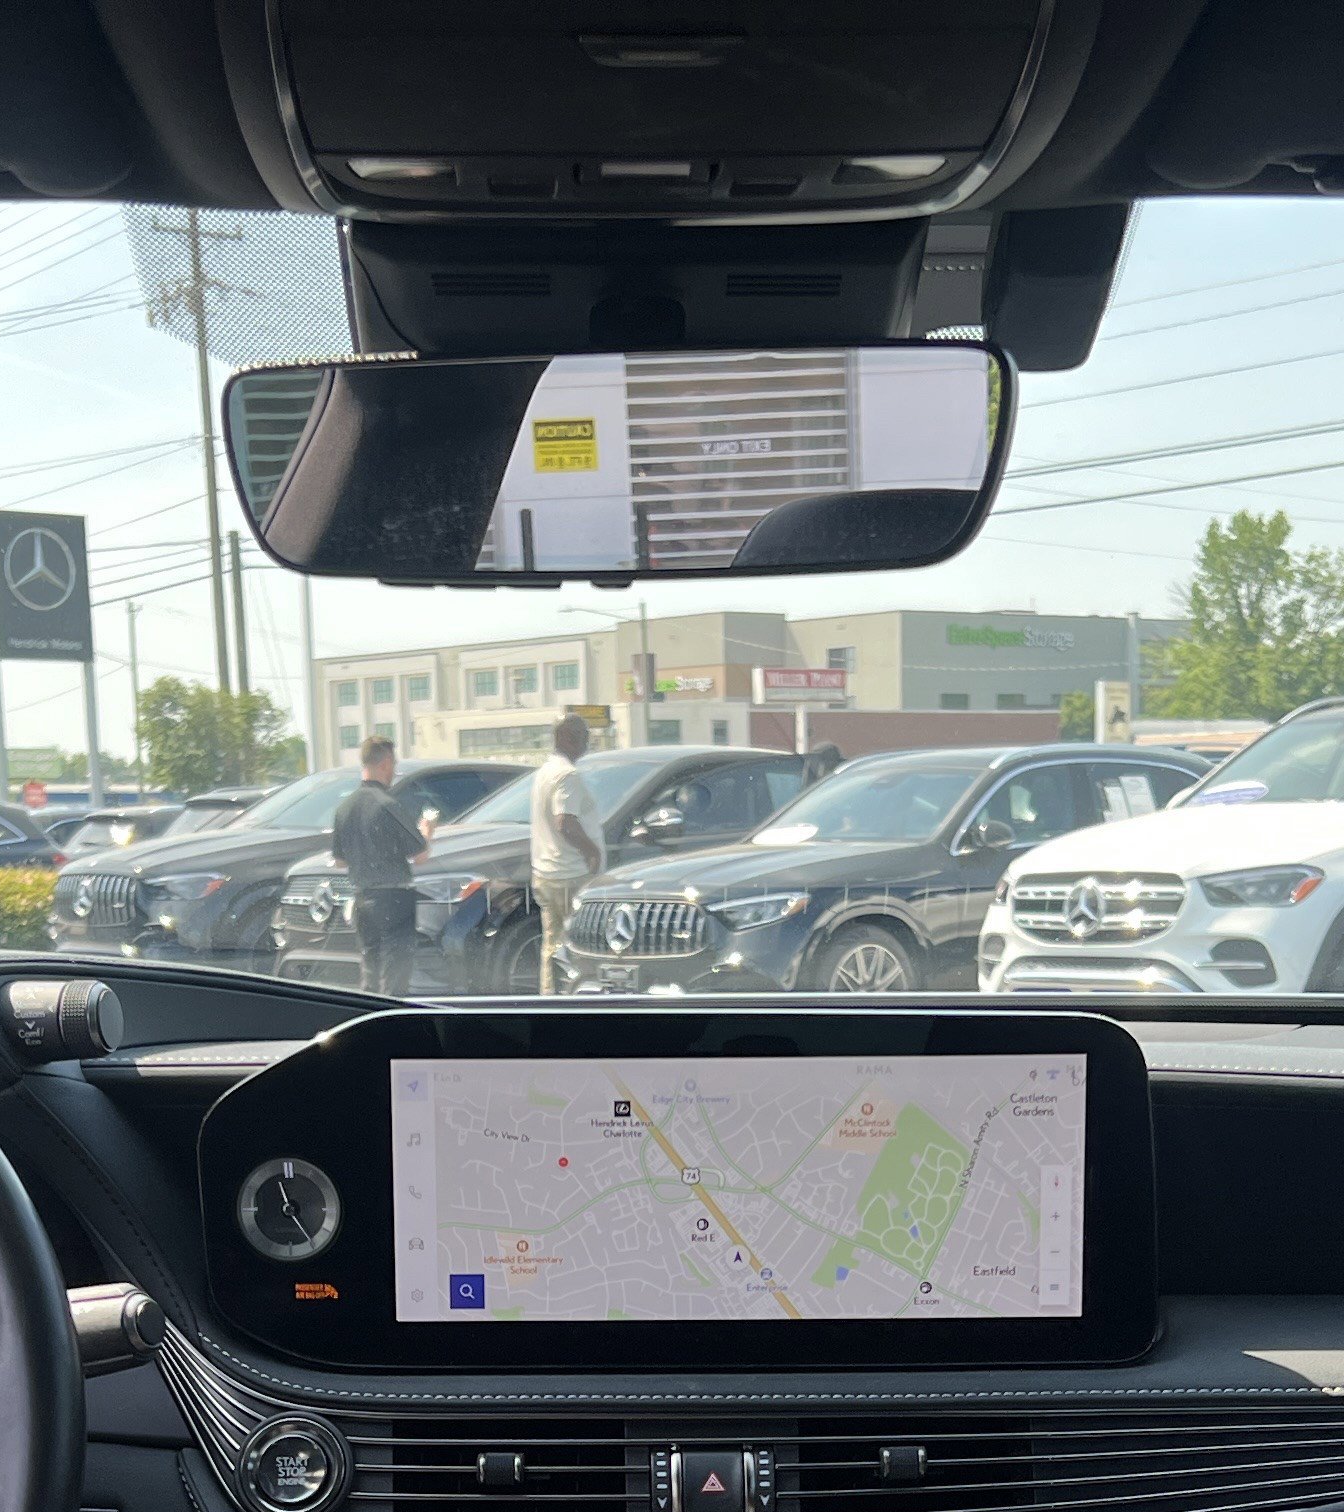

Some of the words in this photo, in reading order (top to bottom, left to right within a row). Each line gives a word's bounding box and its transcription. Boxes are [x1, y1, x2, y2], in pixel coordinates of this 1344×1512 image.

[1010, 1093, 1058, 1104] Castleton
[1012, 1105, 1055, 1116] Gardens
[685, 1170, 697, 1181] 74
[276, 1456, 309, 1467] START
[277, 1466, 307, 1477] STOP
